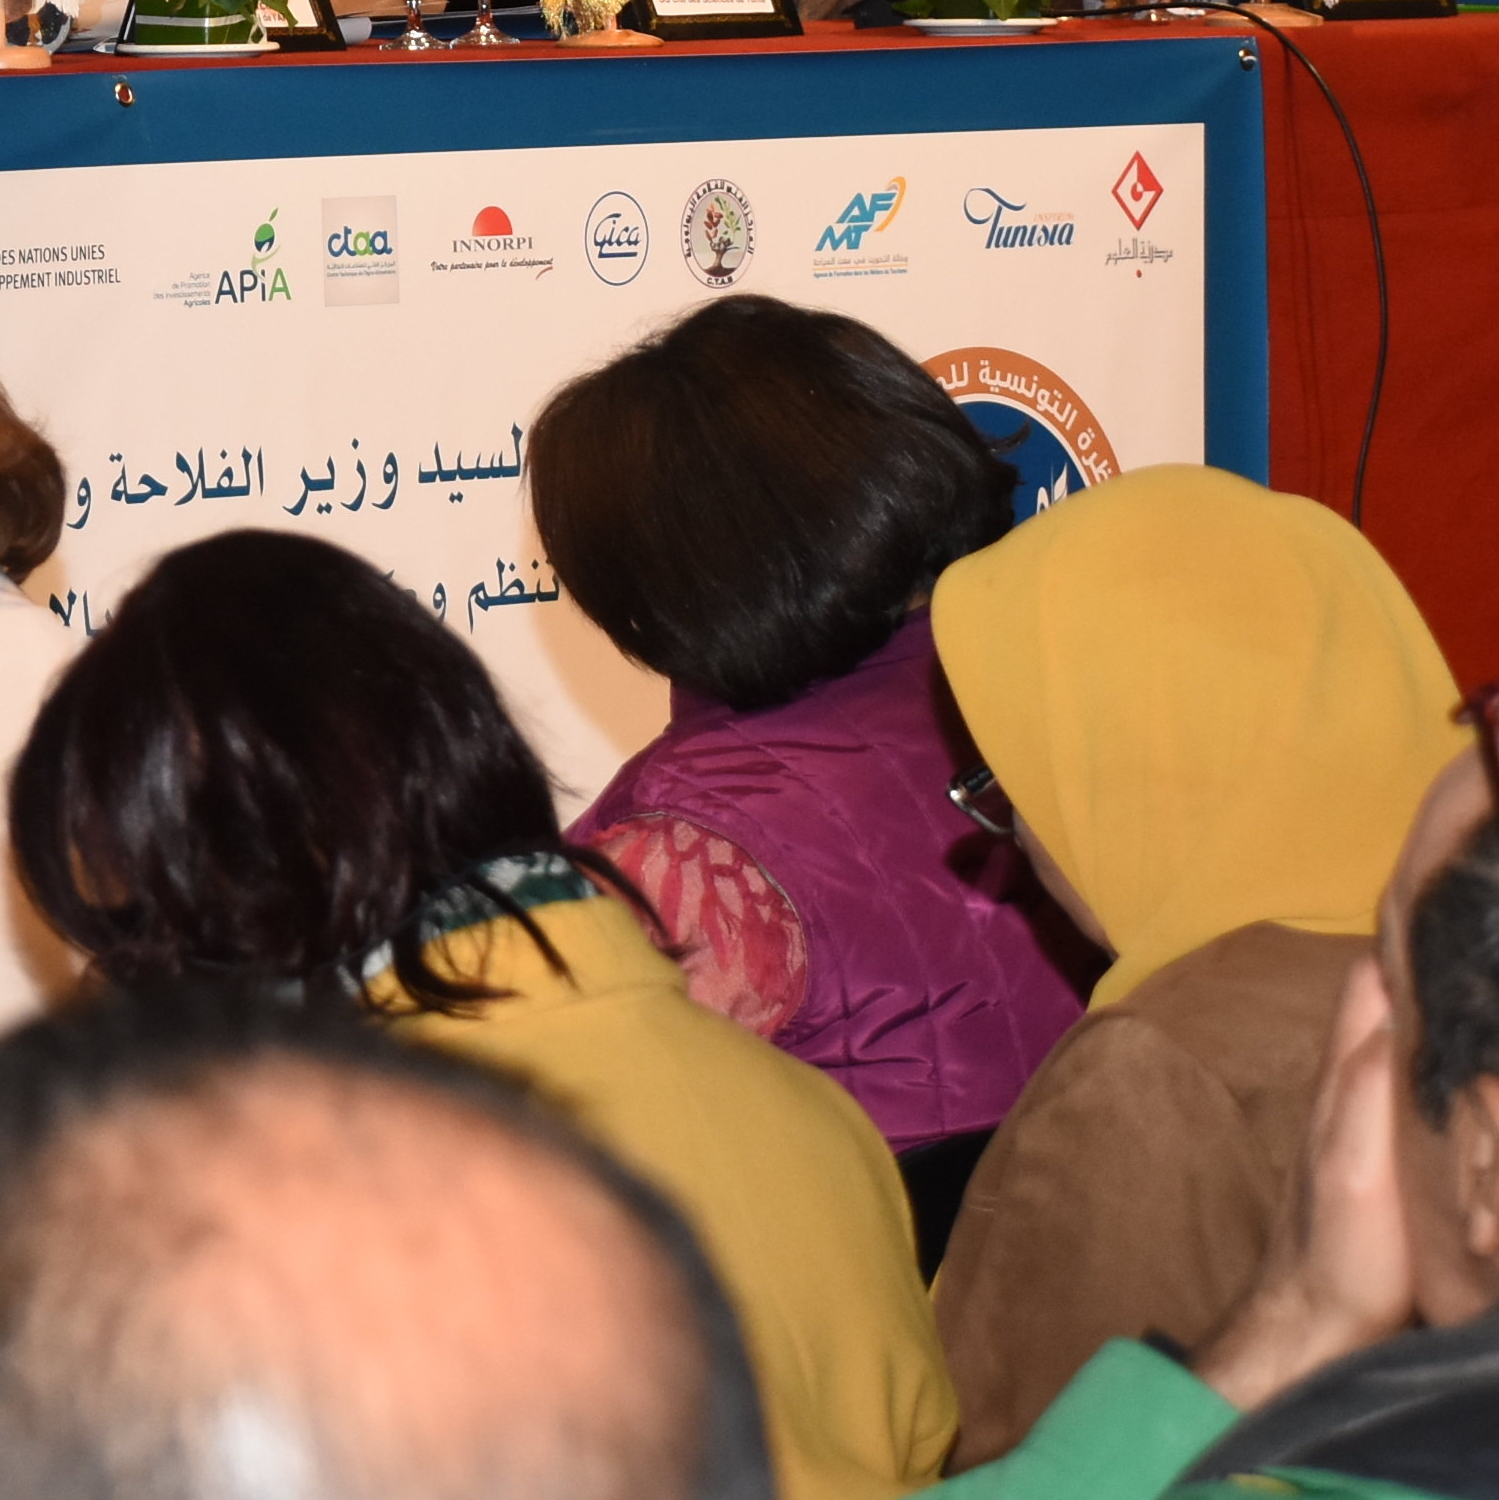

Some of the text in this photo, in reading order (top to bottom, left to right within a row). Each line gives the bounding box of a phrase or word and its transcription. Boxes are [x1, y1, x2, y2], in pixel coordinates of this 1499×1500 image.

[18, 246, 68, 265] NATIONS
[70, 243, 106, 262] UNIES
[327, 225, 393, 258] ctaa
[452, 236, 533, 253] INNORPI
[54, 268, 122, 288] INDUSTRIEL
[978, 359, 1079, 431] التونسية
[109, 445, 265, 506] الفلاحة
[282, 438, 399, 517] وزير
[418, 421, 524, 504] لسيد
